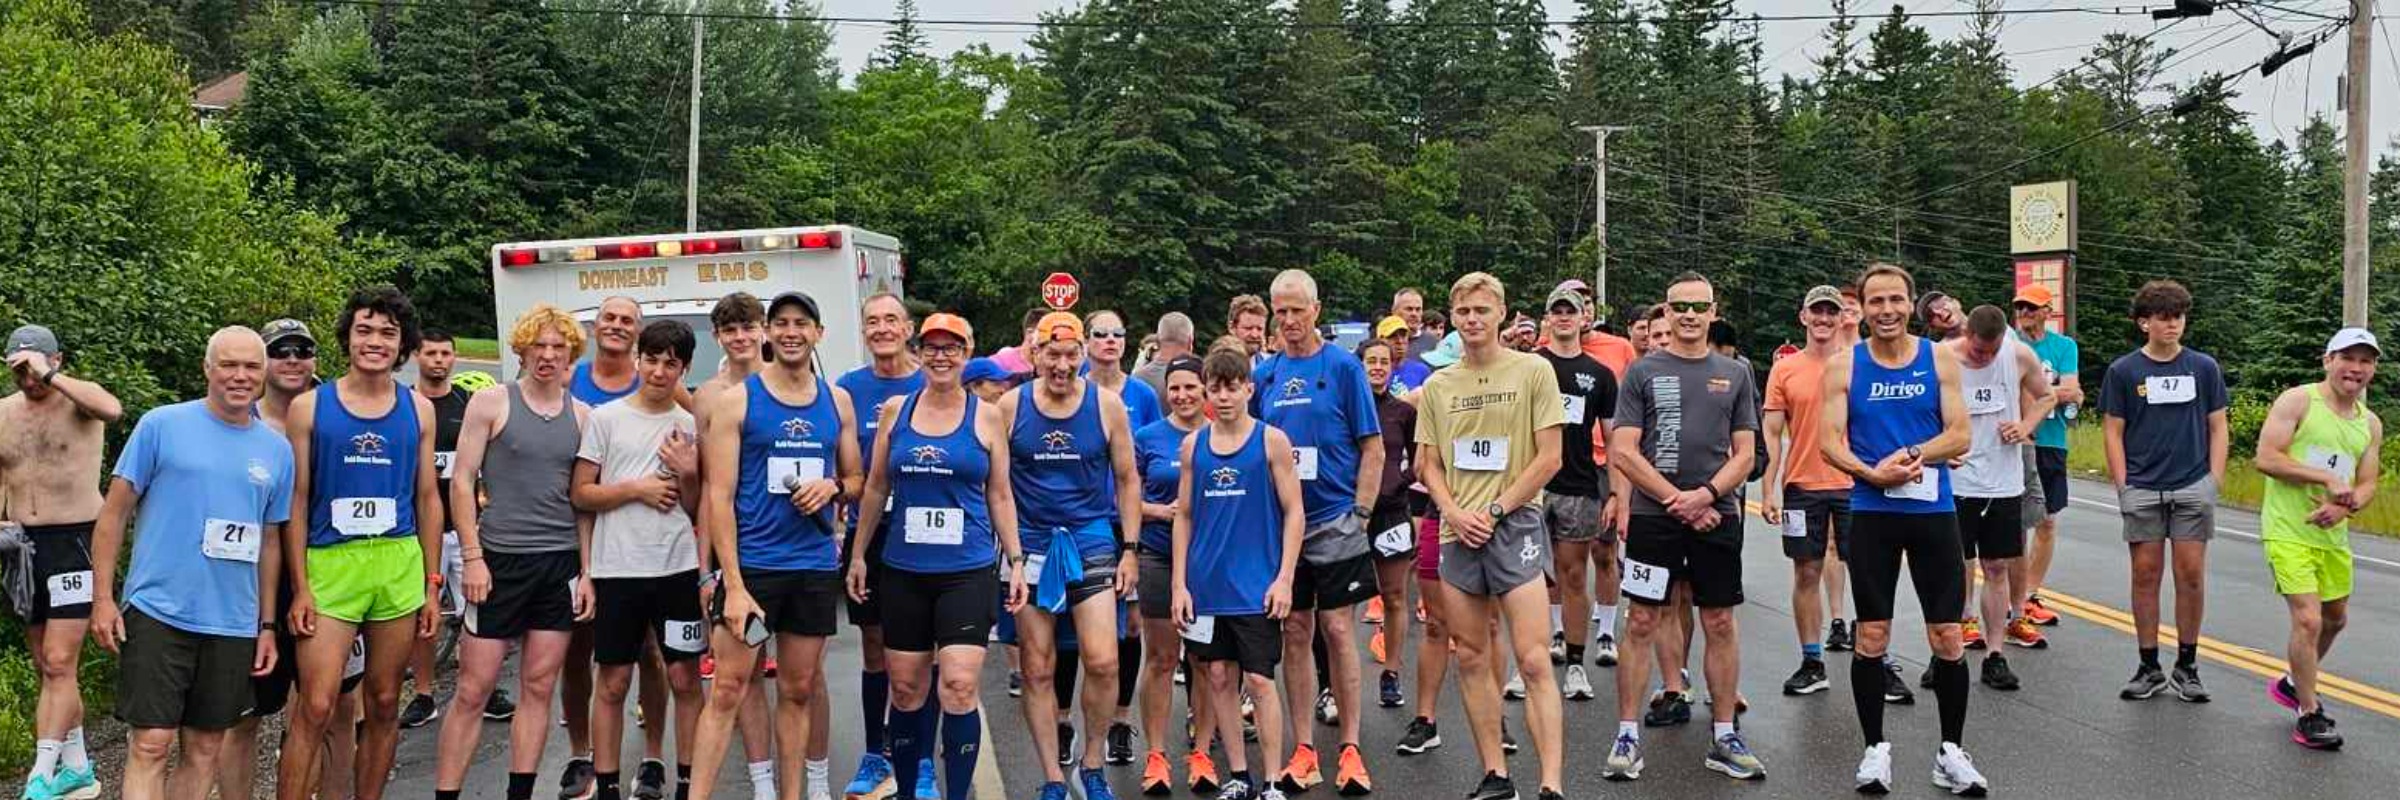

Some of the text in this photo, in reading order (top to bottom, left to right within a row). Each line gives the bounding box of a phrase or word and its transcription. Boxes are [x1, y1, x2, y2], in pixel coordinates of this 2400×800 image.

[578, 261, 769, 291] DOWNEAST EMS
[1045, 283, 1076, 299] STOP
[1869, 381, 1926, 399] Dirigo
[2161, 377, 2179, 391] 47
[1974, 388, 1992, 403] 43
[1471, 440, 1491, 457] 40
[794, 461, 801, 477] 1
[2327, 454, 2337, 469] 4
[353, 501, 376, 519] 20
[925, 510, 945, 528] 16
[224, 523, 246, 543] 21
[1387, 530, 1402, 543] 41
[1632, 564, 1651, 583] 54
[62, 575, 82, 591] 56
[682, 623, 701, 641] 80
